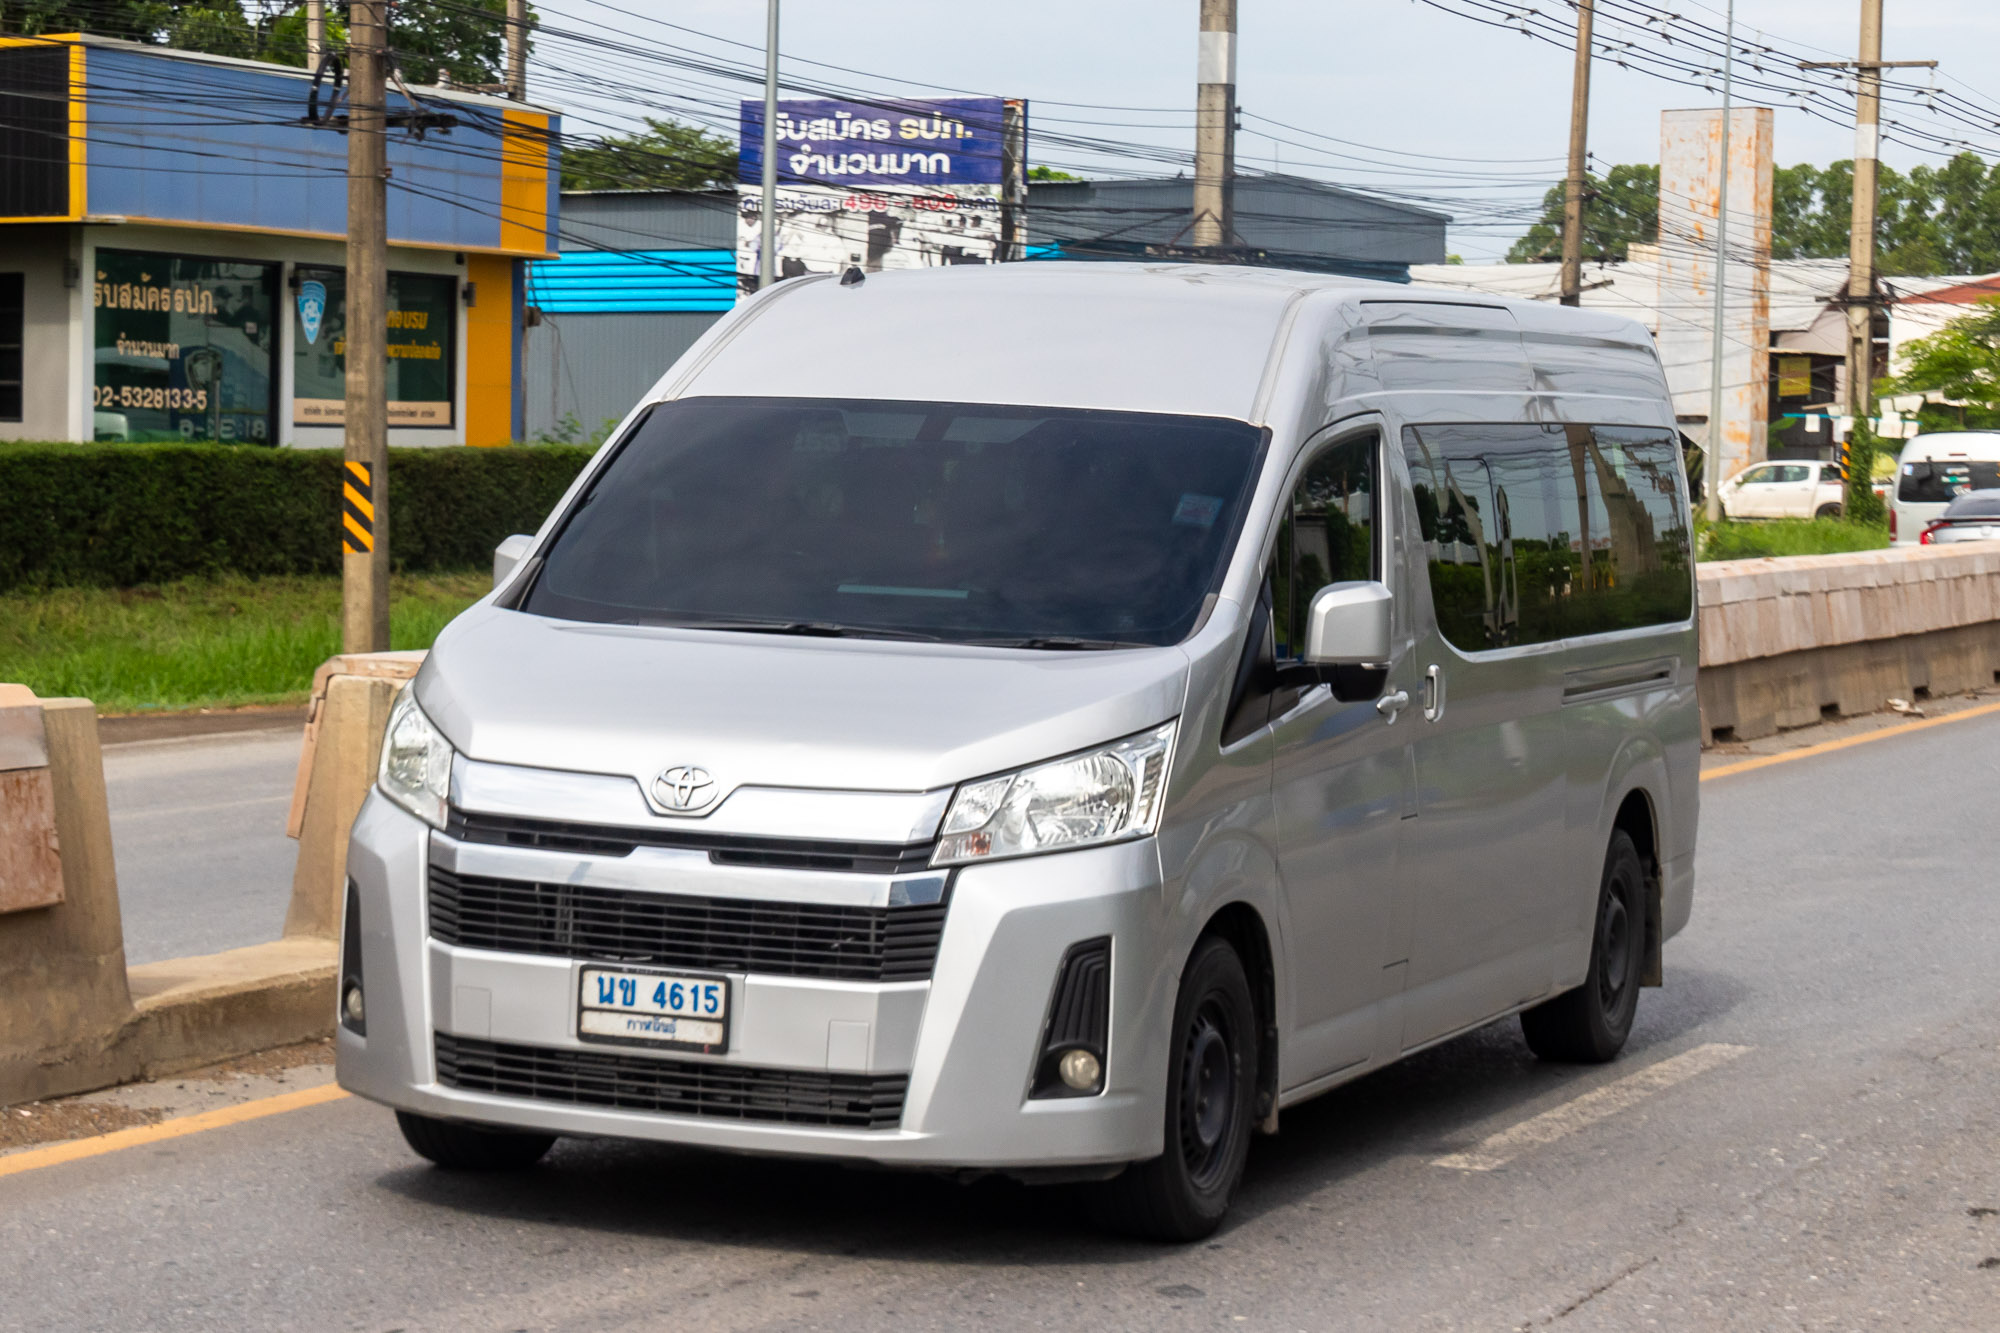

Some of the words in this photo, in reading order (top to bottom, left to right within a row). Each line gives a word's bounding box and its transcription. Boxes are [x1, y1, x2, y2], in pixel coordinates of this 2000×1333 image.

[776, 111, 891, 141] รับสมัคร
[789, 144, 950, 175] จำนวนมาก
[116, 331, 180, 359] จำนวนมาก
[94, 385, 207, 411] 02-5328133-5
[597, 975, 636, 1006] นข
[652, 981, 719, 1014] 4615
